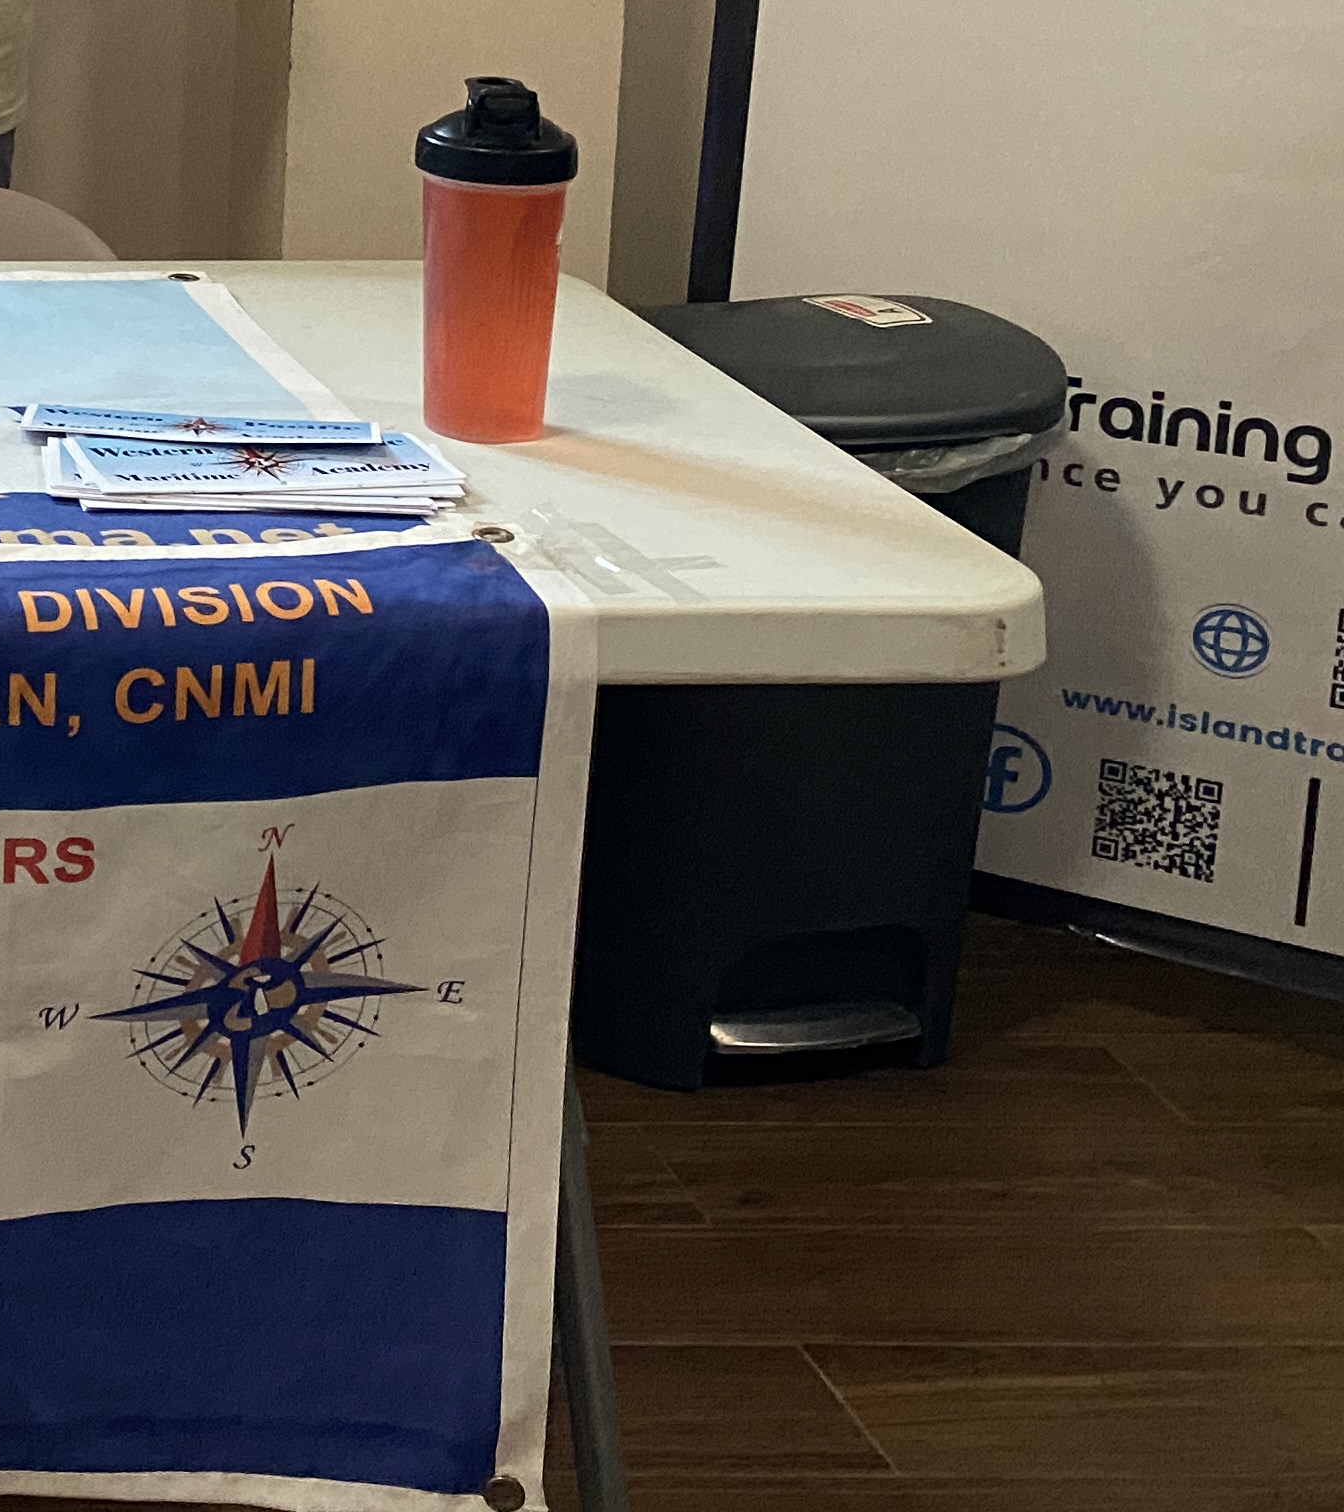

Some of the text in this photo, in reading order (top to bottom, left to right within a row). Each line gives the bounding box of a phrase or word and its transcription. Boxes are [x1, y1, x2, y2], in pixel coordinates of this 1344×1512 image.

[89, 445, 215, 460] Western
[115, 460, 431, 483] Maritime Academy
[1155, 477, 1267, 516] you
[18, 578, 375, 633] DIVISION
[113, 658, 315, 725] CNMI
[259, 823, 295, 851] N
[437, 980, 466, 1004] E
[38, 1004, 80, 1031] W
[233, 1145, 255, 1170] S
